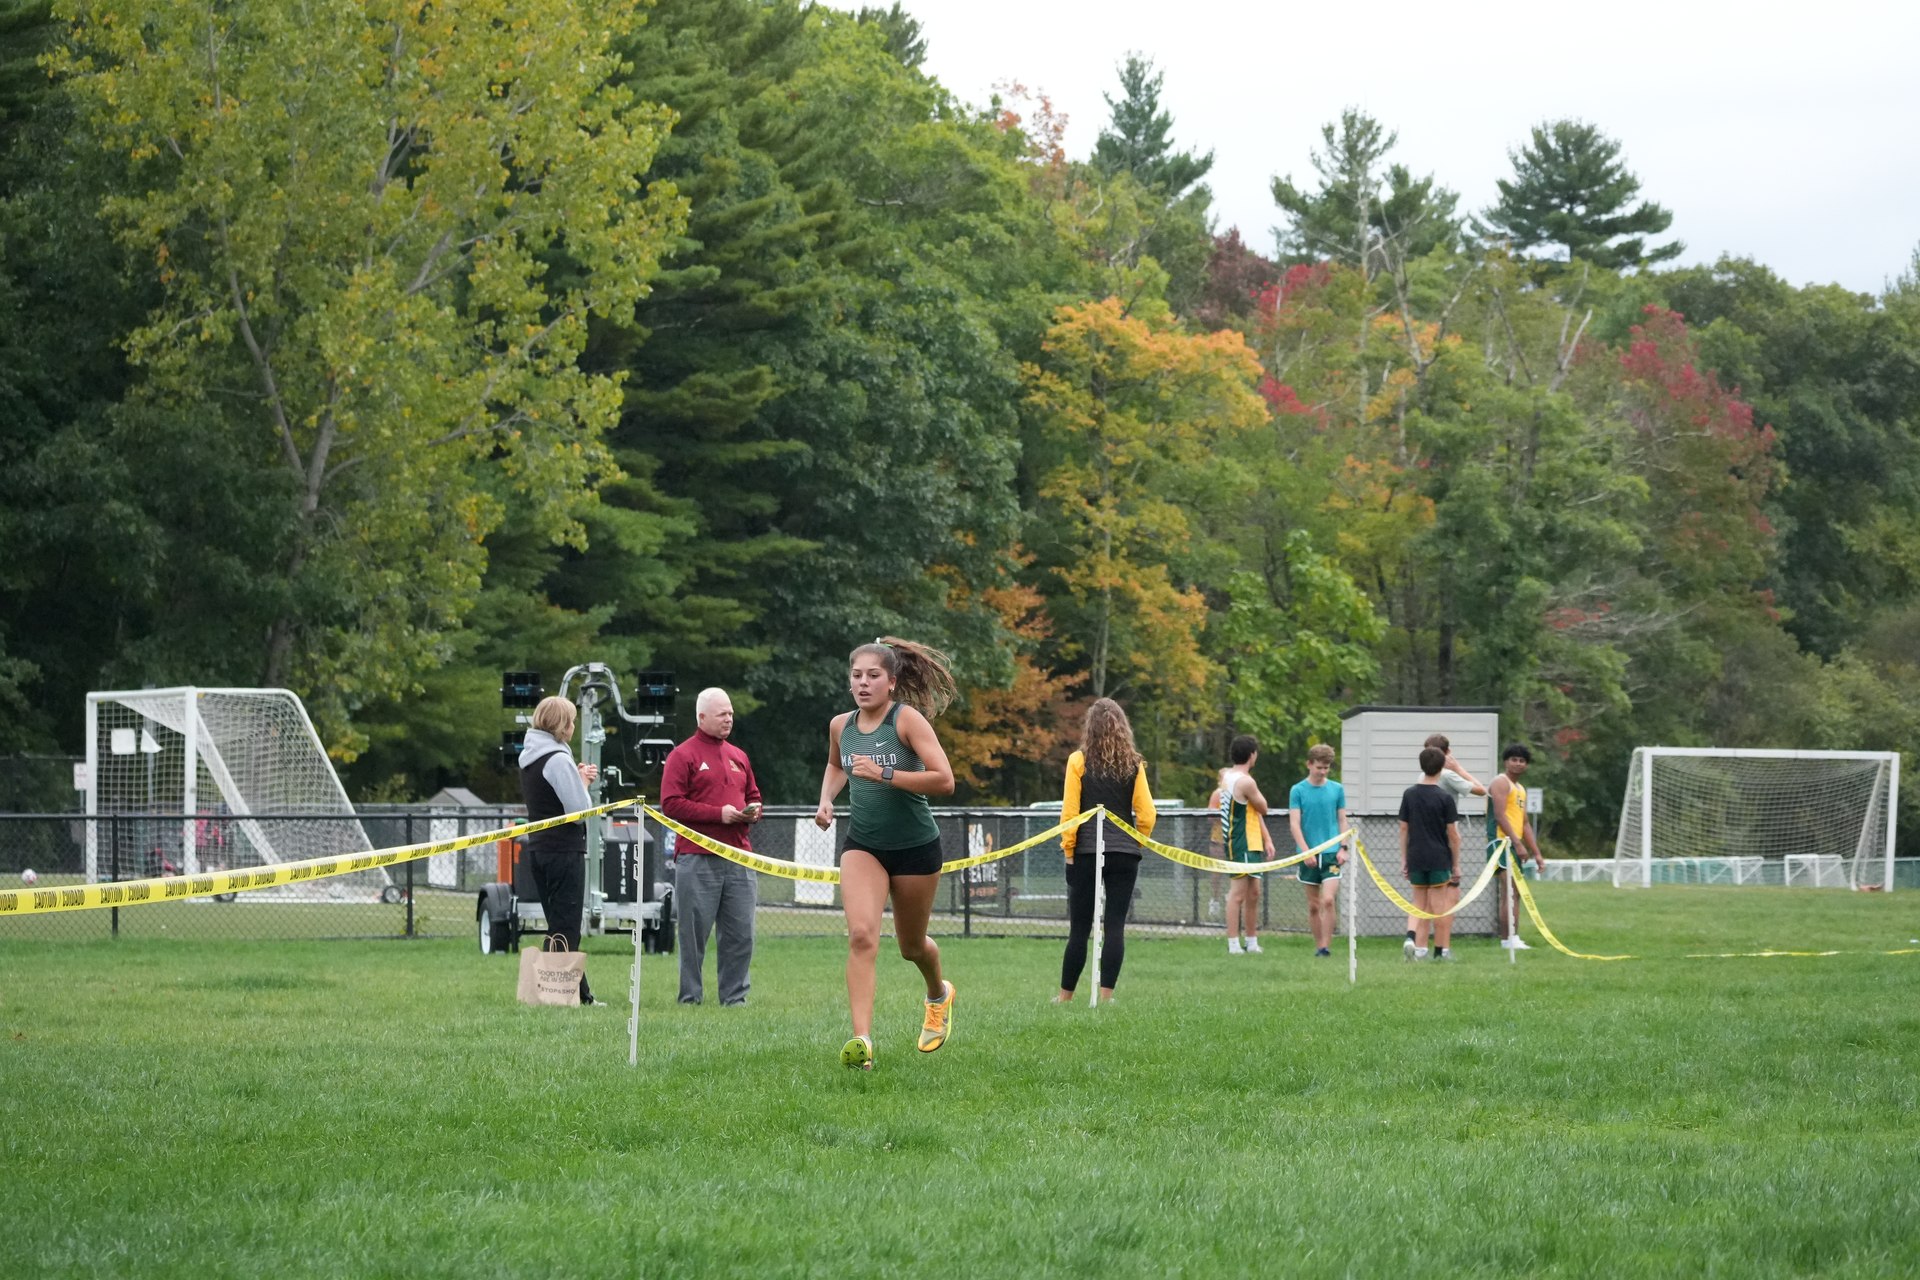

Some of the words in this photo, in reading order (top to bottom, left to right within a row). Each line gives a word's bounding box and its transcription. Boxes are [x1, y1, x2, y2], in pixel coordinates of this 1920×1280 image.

[841, 754, 897, 767] MAIELD
[0, 893, 18, 911] UIDADO
[34, 890, 58, 909] CAUTION
[62, 888, 86, 907] CUIDADO
[100, 886, 123, 904] CAUTION
[127, 883, 151, 901] CUIDADO
[165, 880, 188, 897] CAUTION
[228, 873, 251, 890] CAUTION
[537, 969, 556, 977] GOOD
